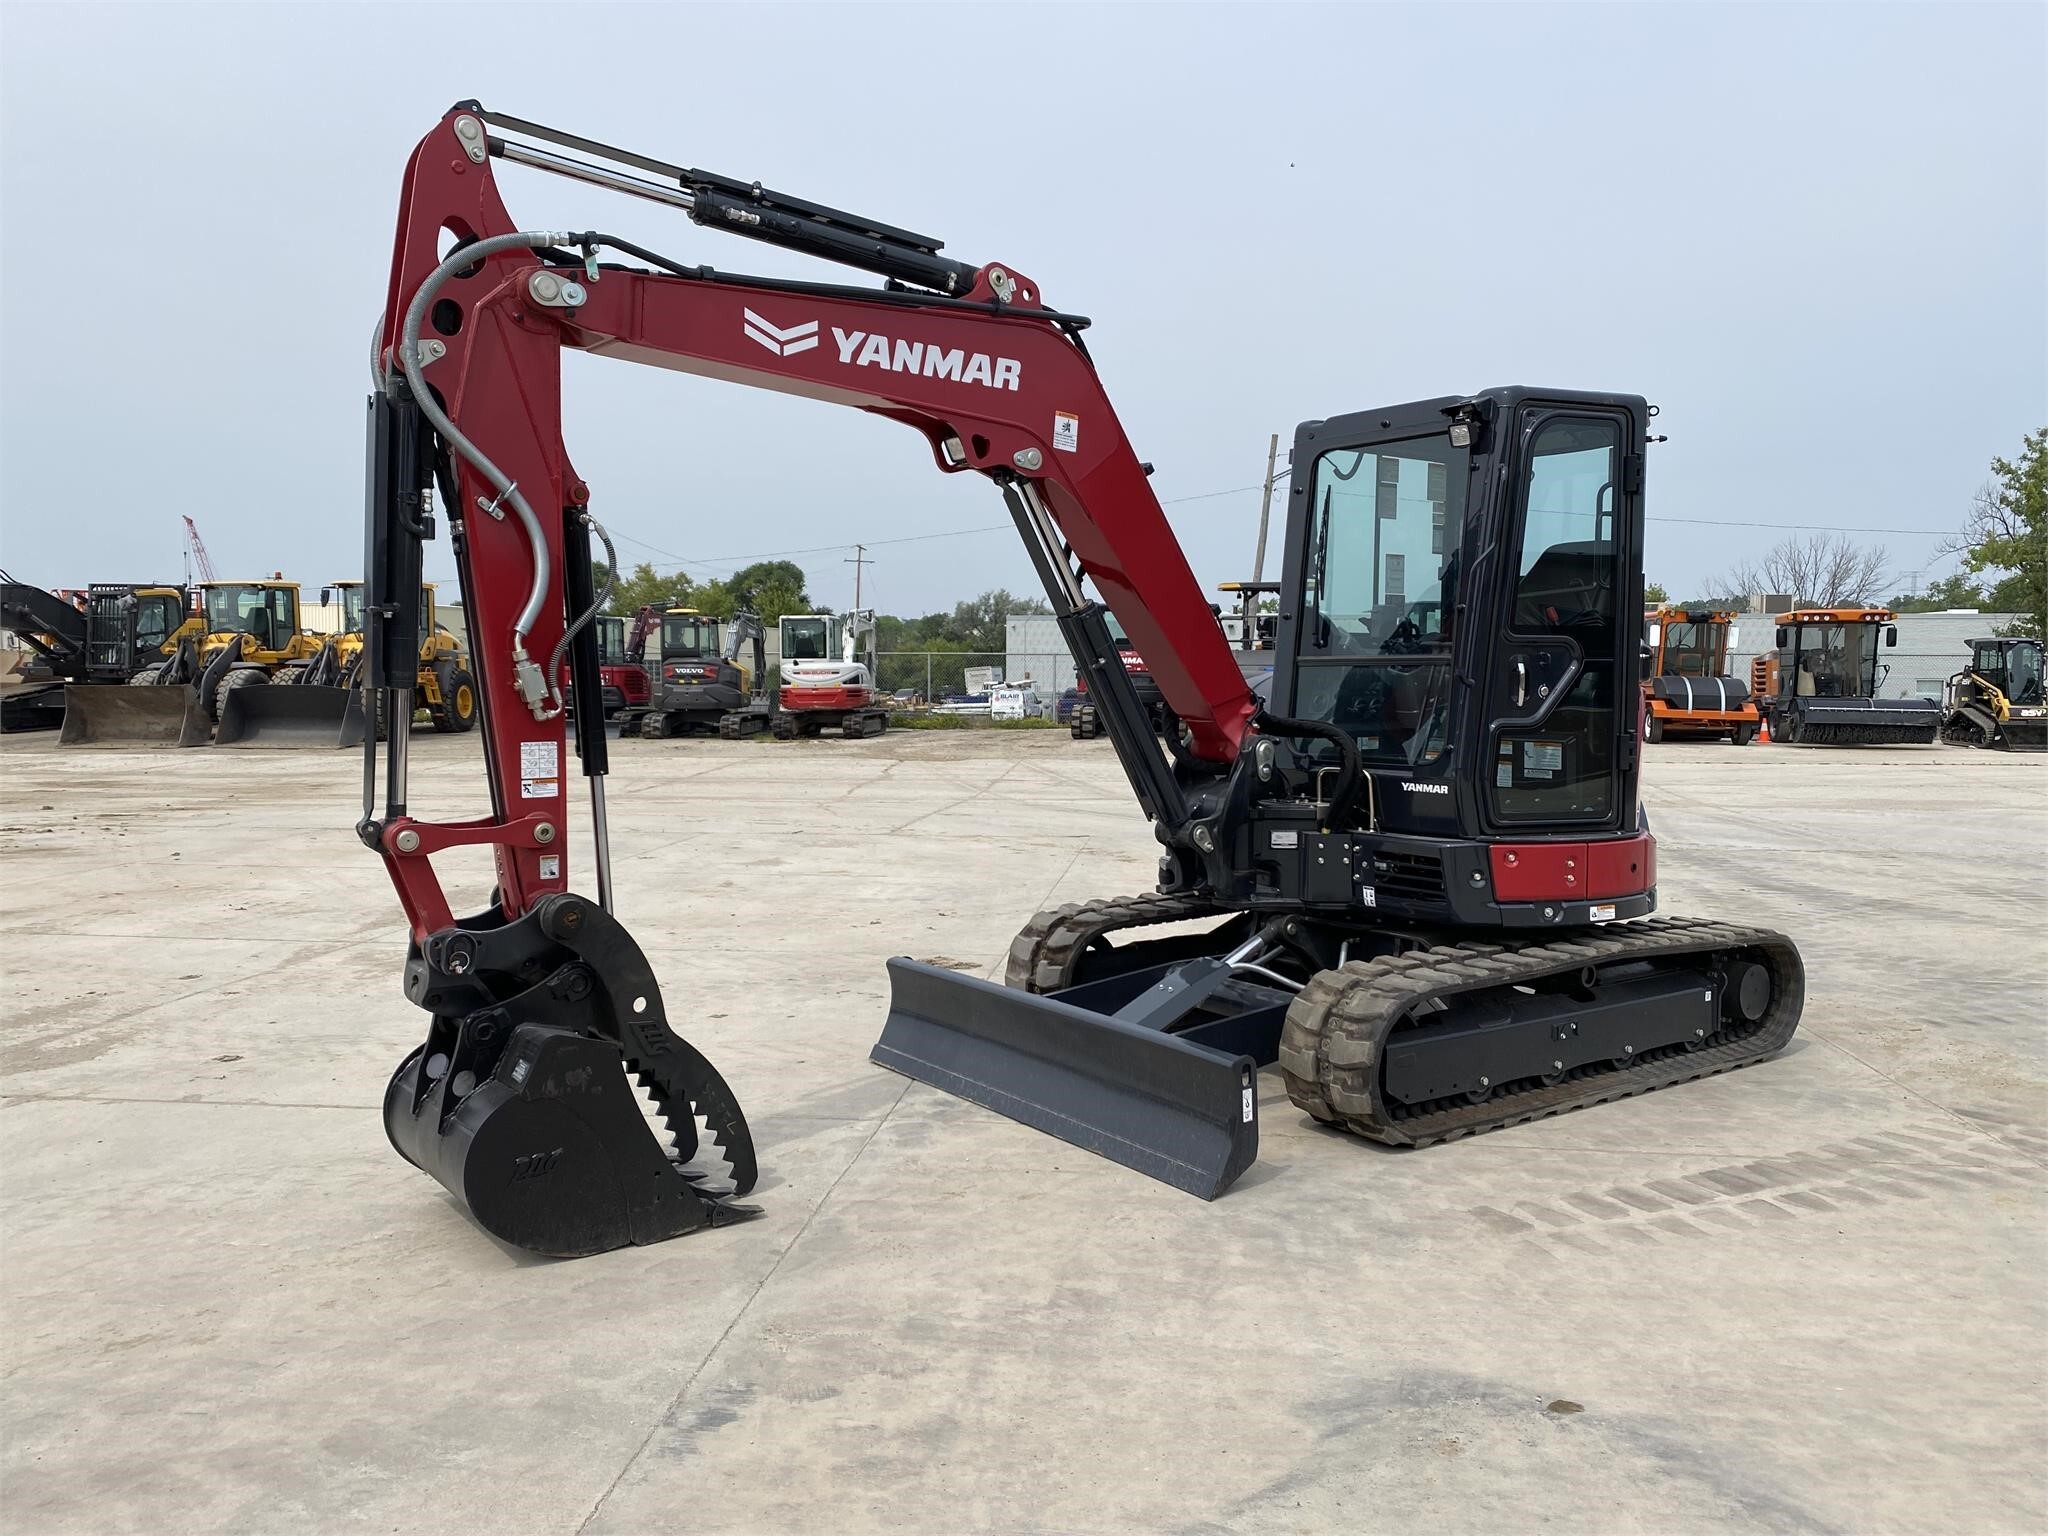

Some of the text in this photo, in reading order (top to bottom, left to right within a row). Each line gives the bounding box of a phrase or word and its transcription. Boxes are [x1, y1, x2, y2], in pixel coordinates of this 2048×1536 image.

[831, 326, 1022, 391] YANMAR
[1121, 657, 1144, 665] NMA
[1401, 782, 1448, 794] YANMAR
